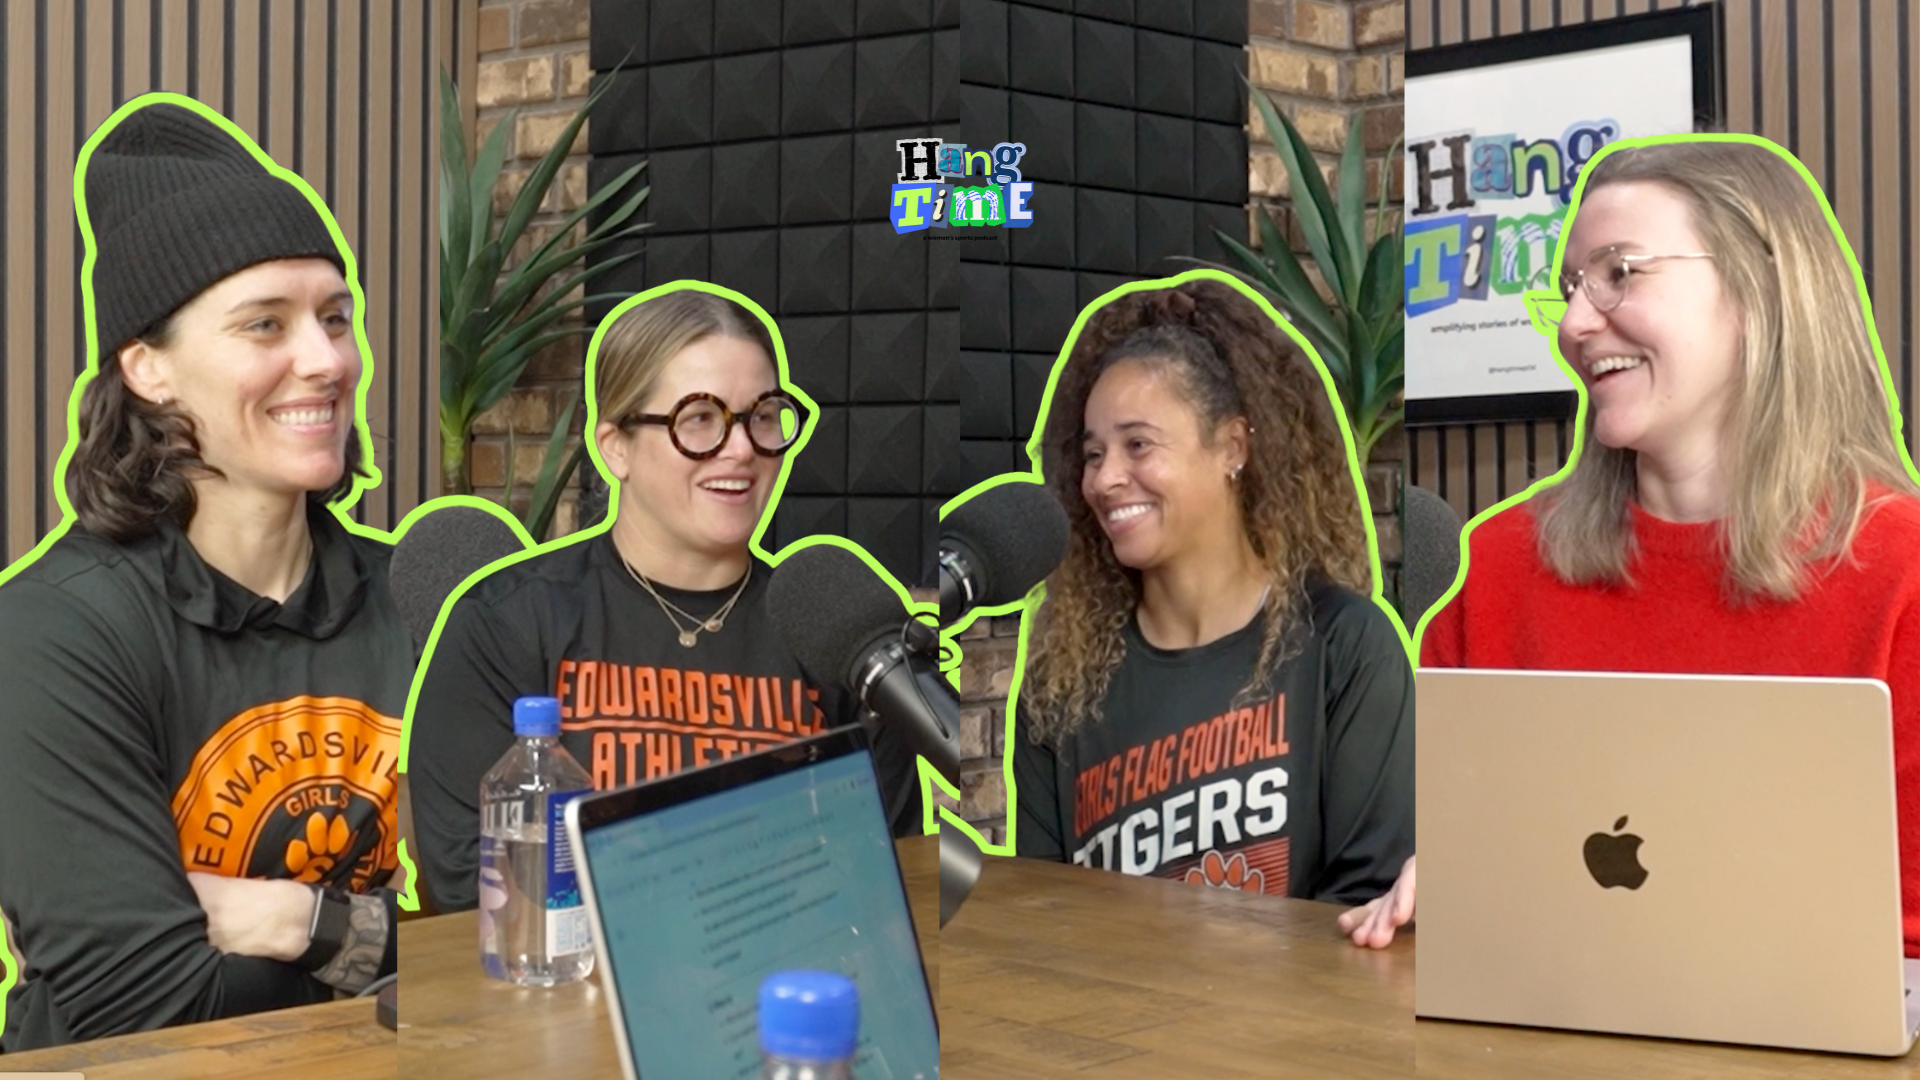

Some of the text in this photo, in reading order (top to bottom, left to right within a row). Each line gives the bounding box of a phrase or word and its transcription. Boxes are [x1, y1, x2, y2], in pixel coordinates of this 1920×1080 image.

[1407, 123, 1615, 216] Hang
[1403, 218, 1564, 305] Tim
[1478, 319, 1507, 330] stories
[1509, 317, 1519, 328] of
[1121, 734, 1177, 808] FLAG
[1176, 692, 1290, 785] FOOTBALL
[285, 786, 350, 817] GIRLS
[1072, 766, 1289, 877] TIGERS
